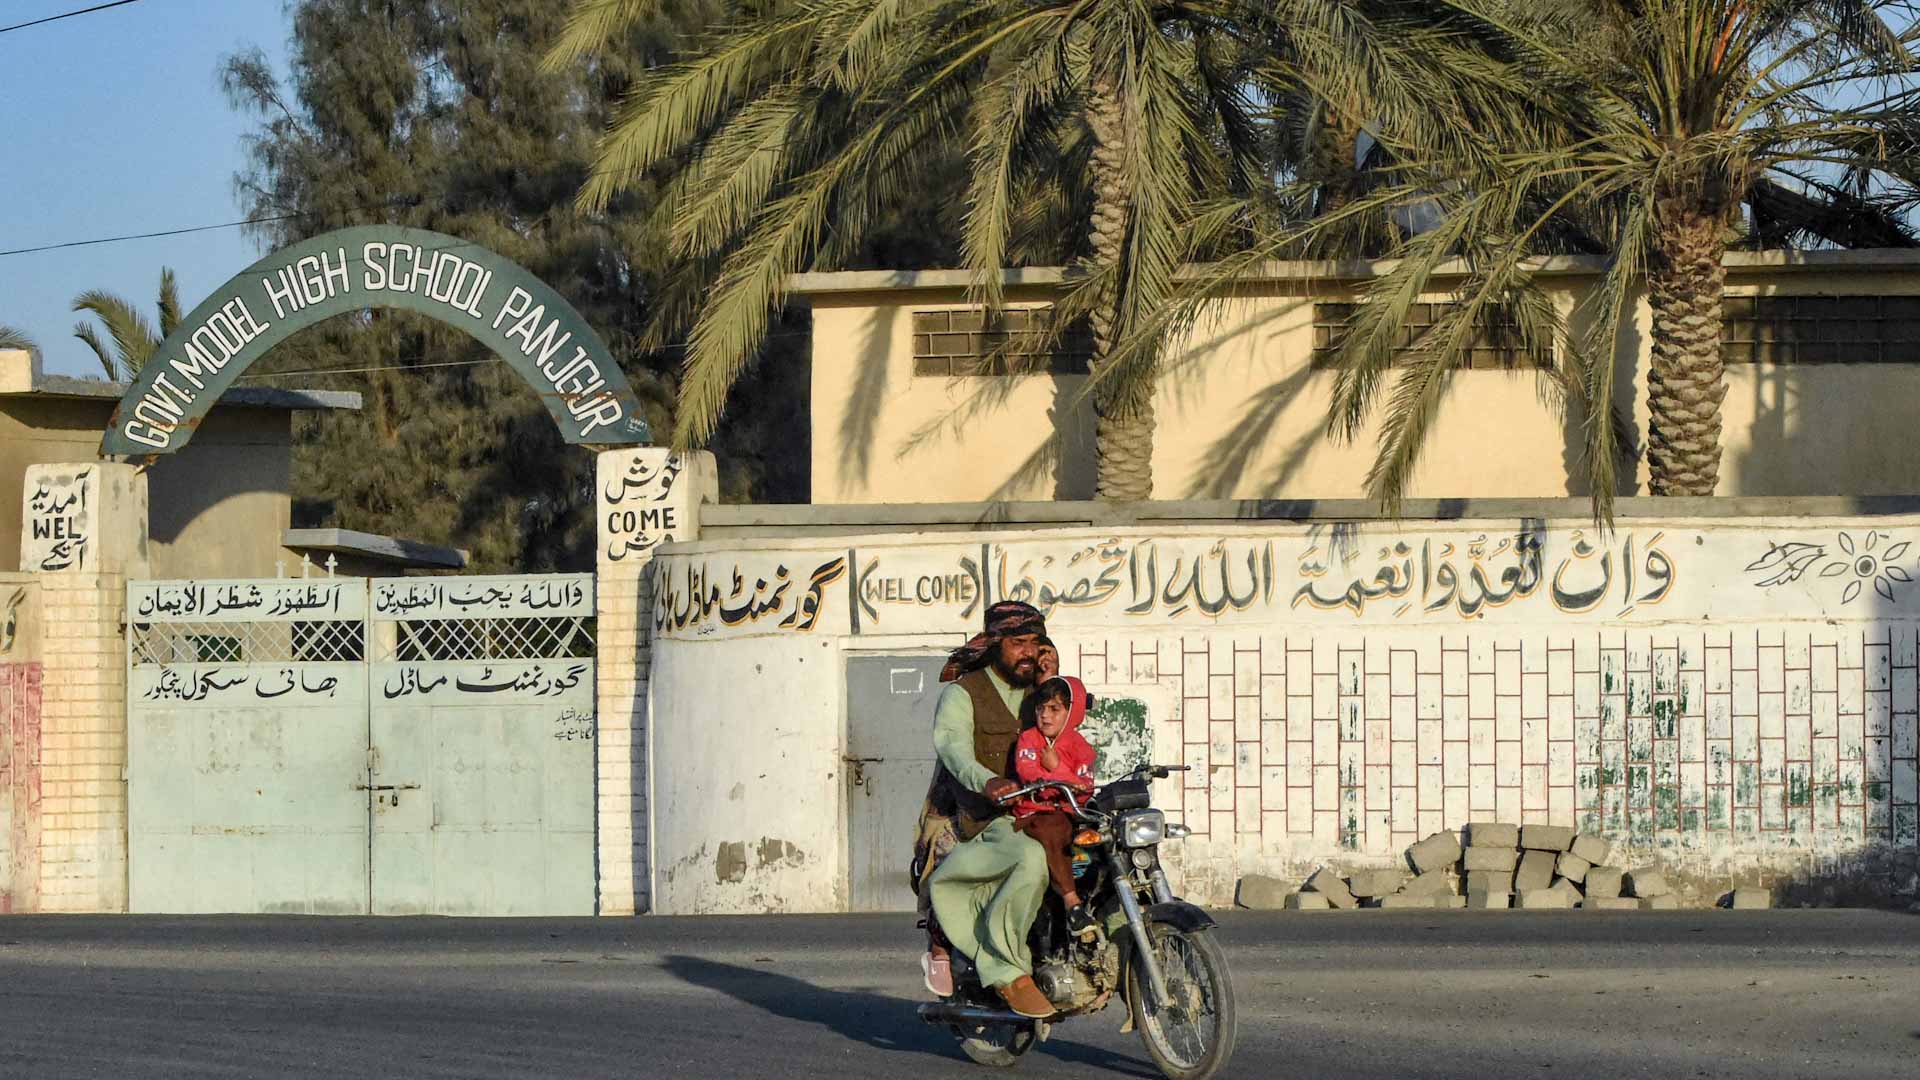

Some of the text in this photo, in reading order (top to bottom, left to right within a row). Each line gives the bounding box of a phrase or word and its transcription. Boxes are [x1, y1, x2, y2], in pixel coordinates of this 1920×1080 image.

[168, 296, 271, 391] MODEL
[261, 247, 351, 319] HIGH
[362, 241, 494, 319] SCHOOL
[490, 285, 624, 437] PANJGUR
[32, 517, 82, 540] WEL
[607, 507, 677, 534] COME
[384, 664, 588, 699] گورنمنٹ ماڈل
